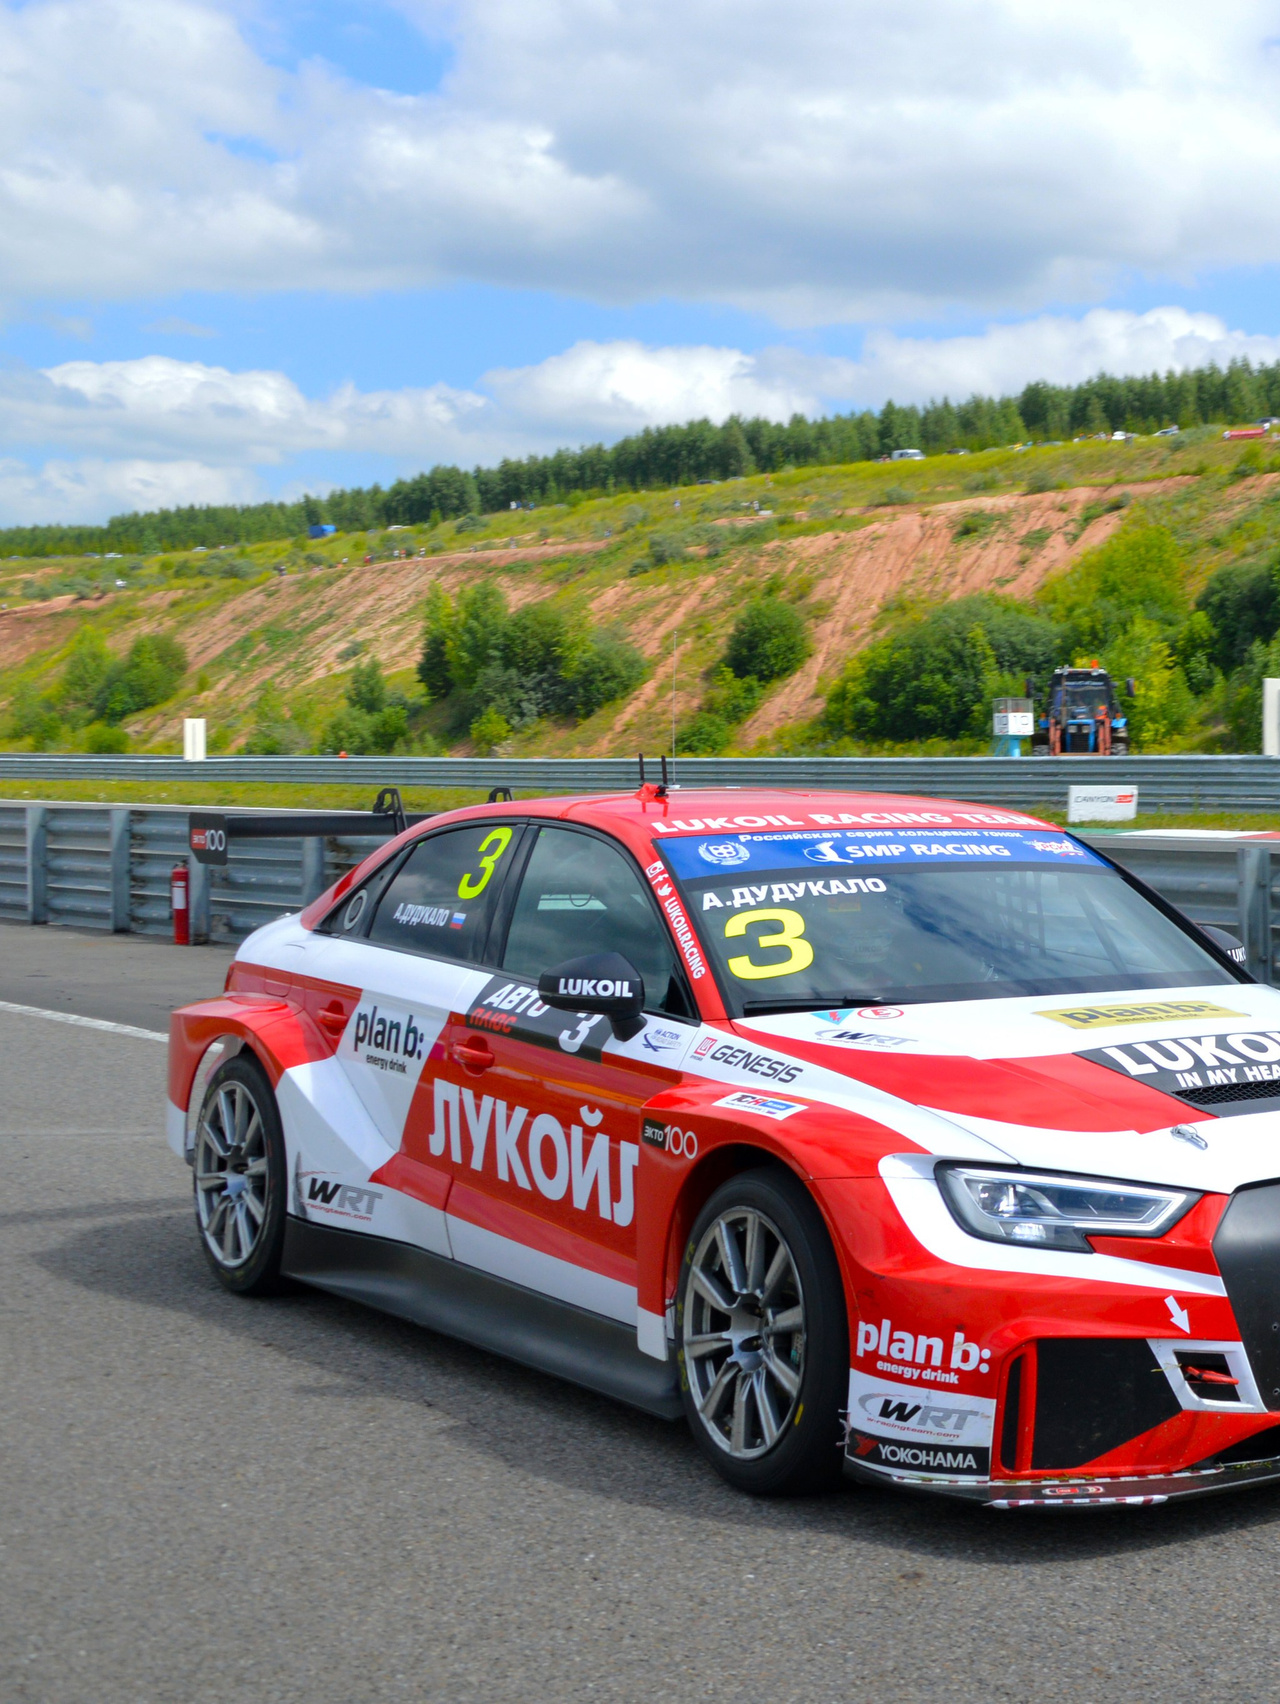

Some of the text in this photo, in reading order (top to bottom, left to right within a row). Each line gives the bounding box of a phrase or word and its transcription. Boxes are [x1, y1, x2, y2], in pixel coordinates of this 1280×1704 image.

[651, 812, 1048, 833] LUKOIL RACING TEAM
[738, 830, 1024, 843] Российская серия кольцевых гонок
[457, 827, 513, 900] 3
[845, 844, 906, 858] SMP
[909, 843, 1012, 857] RACING
[702, 878, 887, 911] А.ДУДУКАЛО
[393, 902, 450, 927] А.ДУДУКАЛО
[664, 896, 706, 979] LUKOILRACING
[724, 908, 815, 980] 3
[558, 977, 633, 998] LUKOIL
[354, 1005, 401, 1054] plan
[469, 1007, 518, 1034] ПЛЮС
[558, 1012, 605, 1053] 3
[661, 1030, 681, 1040] ACTION
[831, 1031, 919, 1046] WRT
[366, 1054, 407, 1074] energy drink
[710, 1045, 804, 1083] GENESIS
[1175, 1071, 1203, 1088] IN
[1207, 1067, 1242, 1085] MY
[664, 1124, 699, 1160] 100
[308, 1177, 384, 1215] WRT
[303, 1202, 372, 1222] -racingteam.com
[856, 1318, 992, 1374] plan b:
[876, 1360, 960, 1385] energy drink
[878, 1398, 980, 1431] WRT
[878, 1443, 978, 1469] YOKOHAMA
